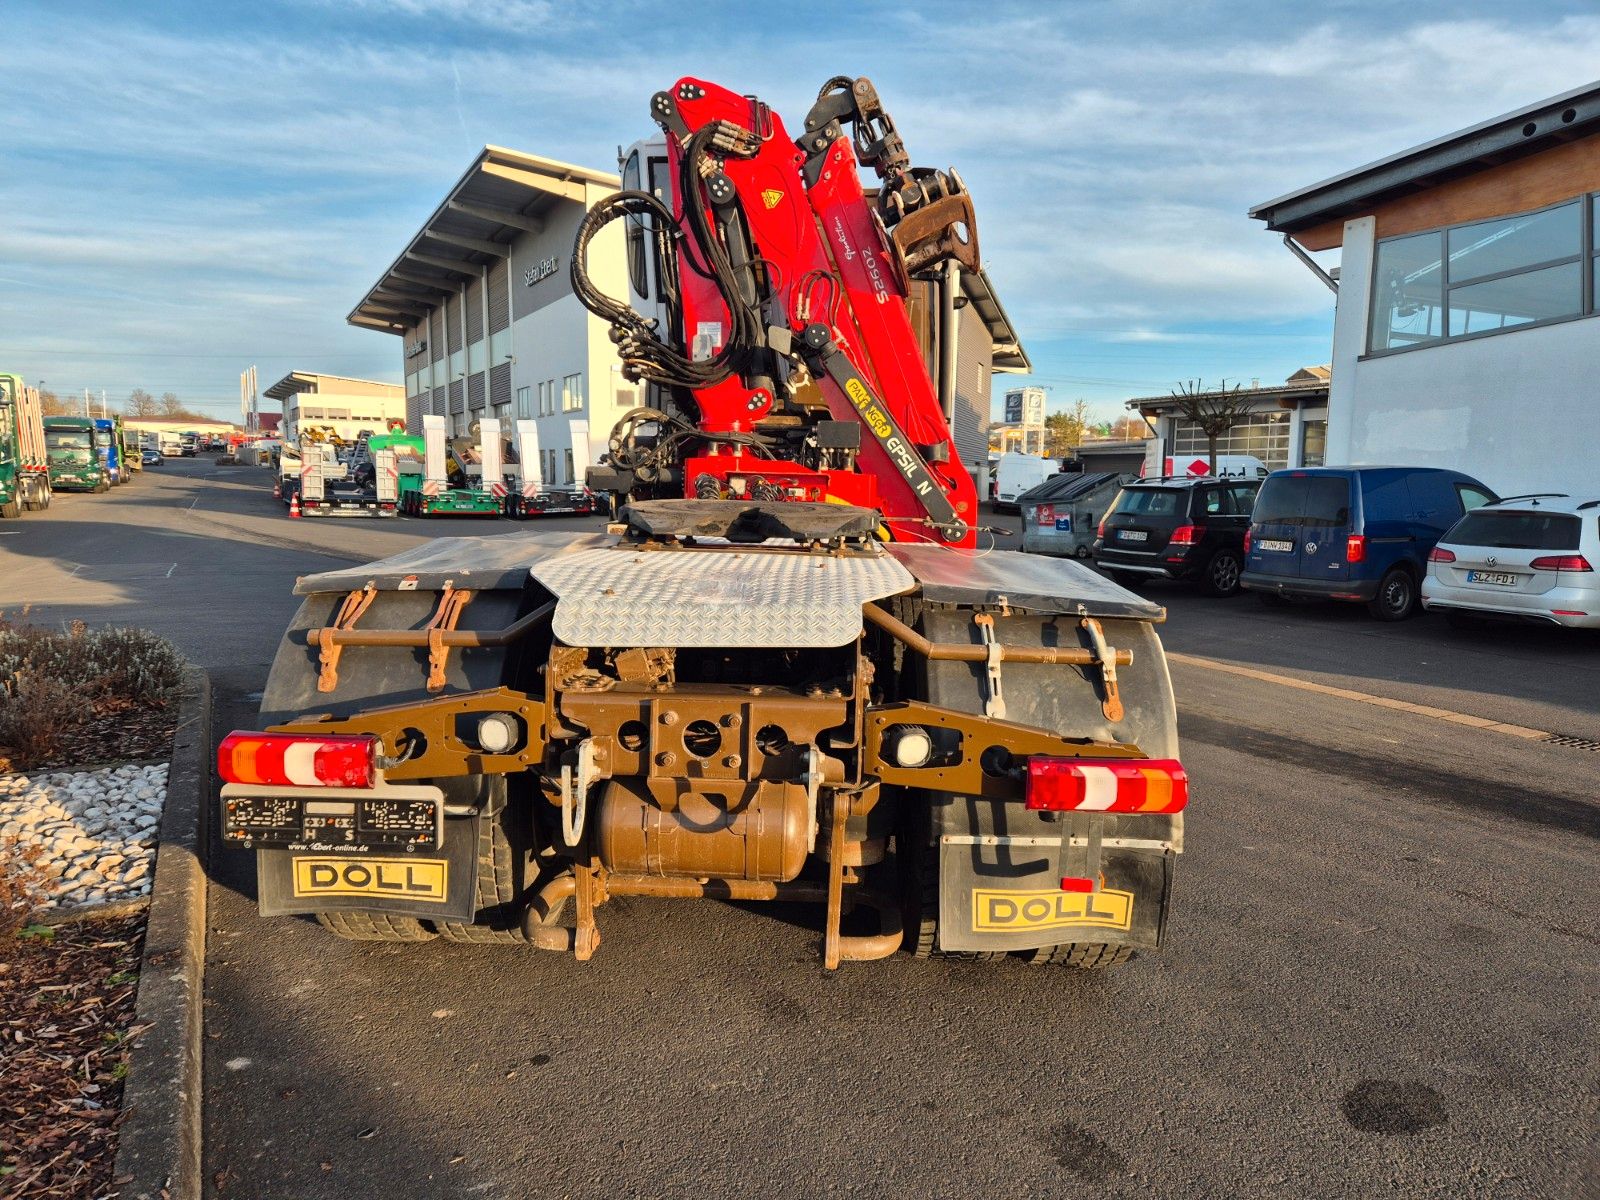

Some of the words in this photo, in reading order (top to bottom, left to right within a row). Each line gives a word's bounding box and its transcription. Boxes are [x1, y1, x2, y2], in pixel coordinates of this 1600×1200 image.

[862, 246, 890, 304] S260Z
[848, 380, 890, 436] PALFNGER
[886, 437, 933, 496] EPSILN
[1472, 572, 1490, 582] SLZ
[1495, 574, 1508, 583] FD
[310, 865, 432, 891] DOLL
[989, 895, 1114, 923] DOLL
